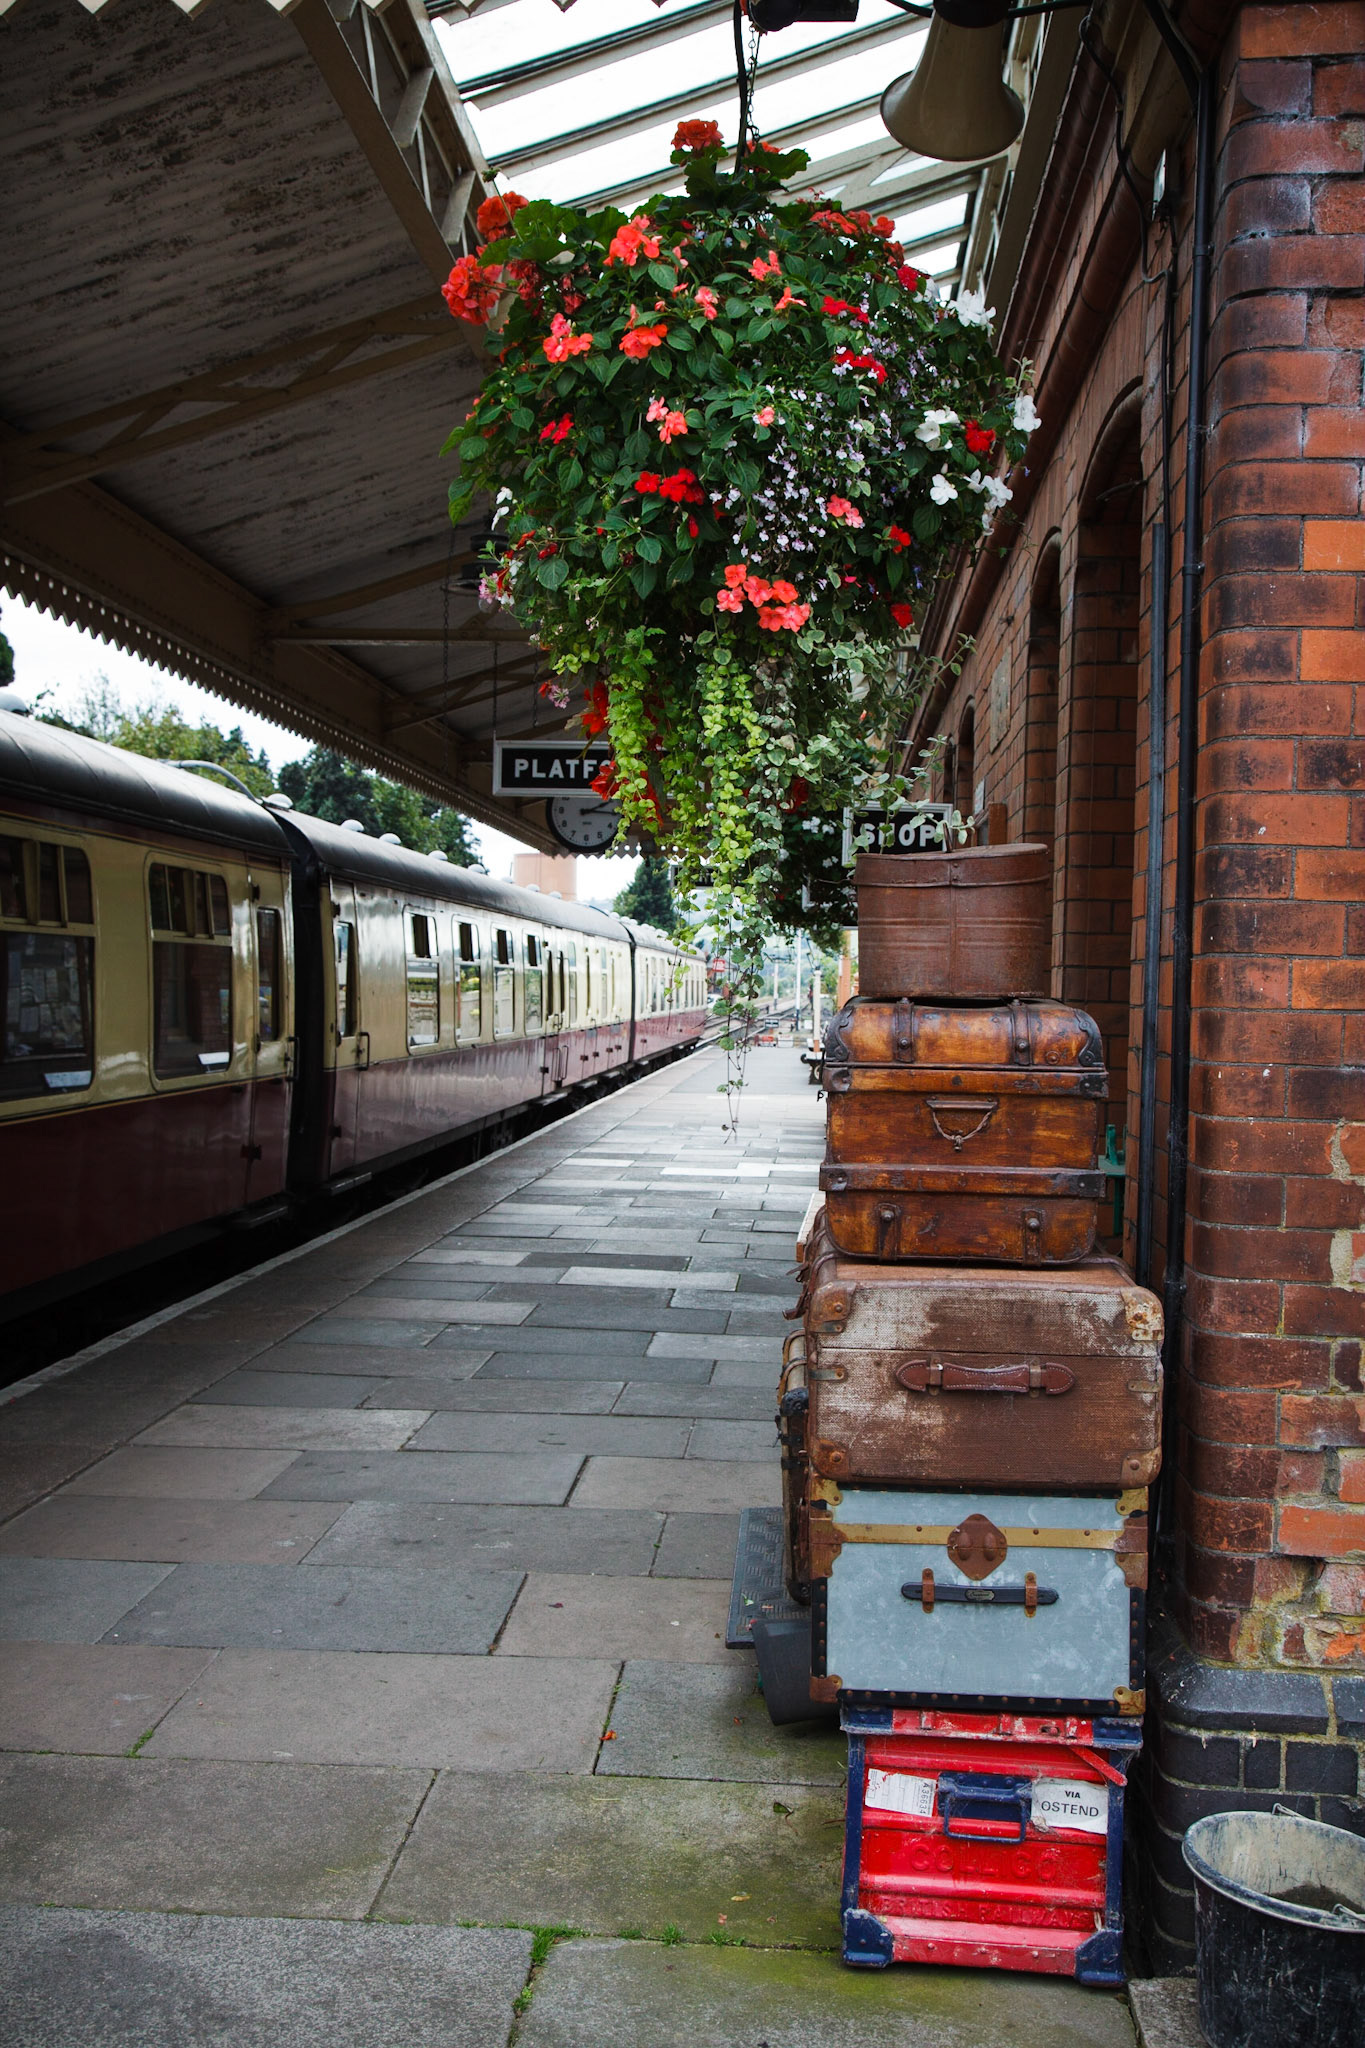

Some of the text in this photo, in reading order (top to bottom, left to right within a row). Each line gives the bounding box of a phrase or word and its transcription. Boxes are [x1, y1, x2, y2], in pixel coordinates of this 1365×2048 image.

[860, 822, 936, 848] SHOP
[1064, 1790, 1081, 1799] VIA
[1041, 1800, 1099, 1817] OSTEND
[880, 1896, 966, 1918] BRITISH
